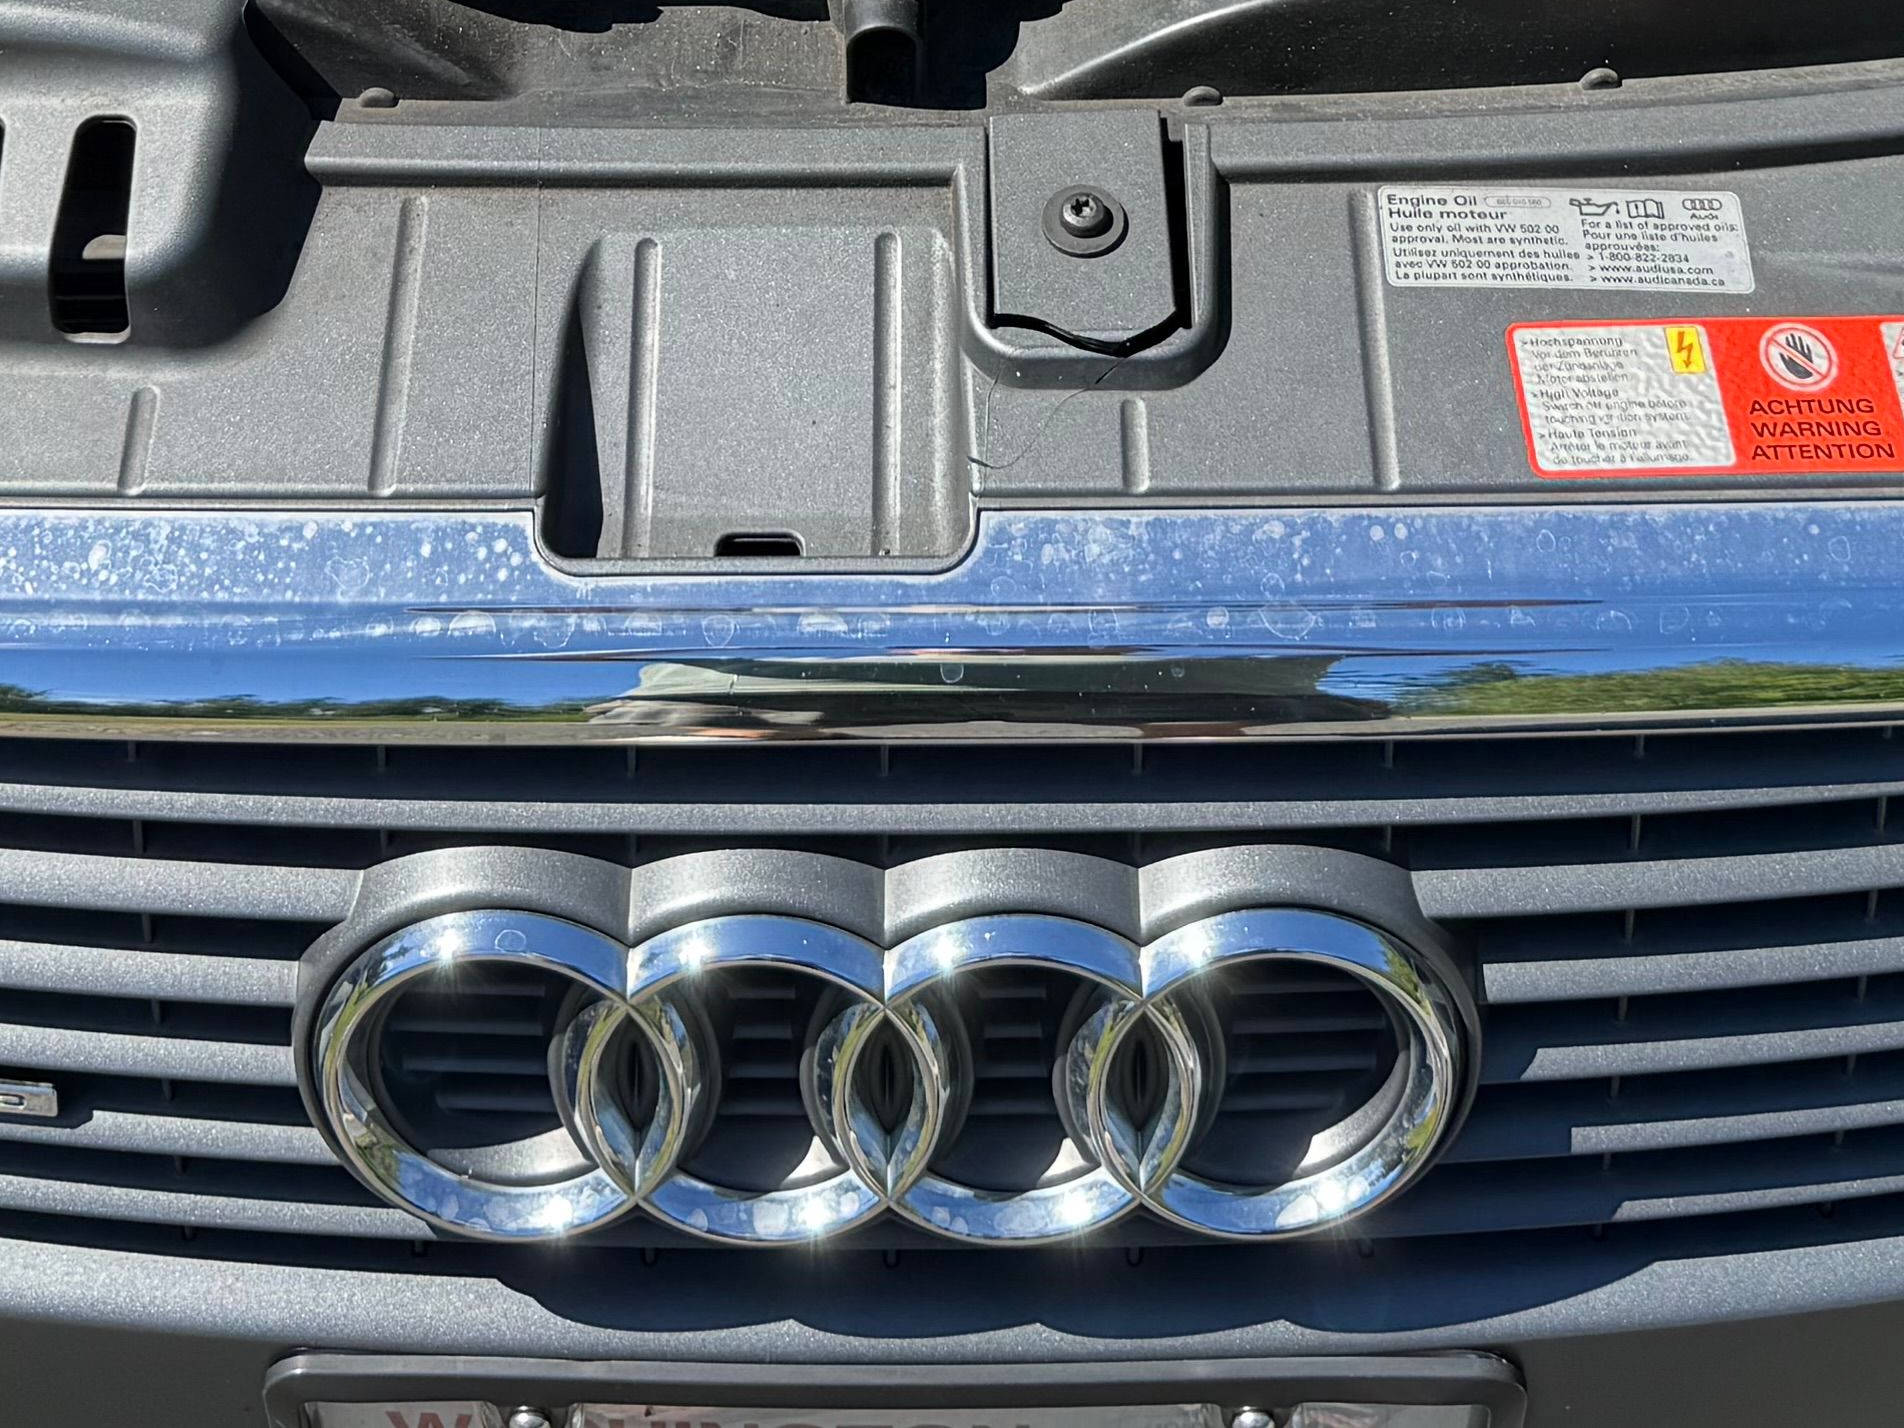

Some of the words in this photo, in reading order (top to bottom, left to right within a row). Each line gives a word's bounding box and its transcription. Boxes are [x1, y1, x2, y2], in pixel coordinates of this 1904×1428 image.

[1387, 194, 1448, 209] Engine
[1454, 195, 1477, 206] Oil
[1388, 207, 1433, 219] Huile
[1440, 209, 1507, 220] moteur
[1690, 212, 1719, 221] Audi
[1390, 223, 1413, 233] Use
[1416, 223, 1442, 233] only
[1446, 223, 1462, 233] oil
[1465, 223, 1492, 233] with
[1494, 224, 1517, 233] VW
[1519, 224, 1541, 234] 502
[1545, 224, 1560, 234] 00
[1581, 219, 1601, 229] For
[1615, 220, 1634, 229] list
[1637, 220, 1649, 230] of
[1652, 222, 1710, 232] approved
[1713, 222, 1739, 233] oils:
[1391, 234, 1449, 245] approval.
[1452, 234, 1484, 244] Most
[1486, 236, 1506, 244] are
[1509, 236, 1569, 246] synthetic.
[1582, 229, 1611, 240] Pour
[1615, 233, 1638, 241] une
[1641, 231, 1666, 241] liste
[1670, 231, 1718, 243] d'huiles
[1392, 247, 1437, 258] Utilisez
[1441, 247, 1515, 260] uniquement
[1518, 248, 1540, 259] des
[1543, 248, 1581, 259] huiles
[1395, 261, 1423, 269] avec
[1426, 260, 1447, 269] VW
[1476, 260, 1491, 269] 00
[1494, 260, 1572, 271] approbation.
[1599, 263, 1714, 275] www.audiusa.com
[1395, 271, 1410, 280] La
[1414, 270, 1458, 281] plupart
[1461, 271, 1488, 280] sont
[1491, 271, 1573, 283] synthétiques.
[1601, 274, 1726, 286] www.audicanada.ca
[1529, 335, 1623, 349] Hochspannung
[1749, 398, 1875, 415] ACHTUNG
[1548, 428, 1585, 439] Haute
[1589, 427, 1637, 439] Tension
[1751, 420, 1882, 438] WARNING
[1751, 443, 1895, 460] ATTENTION
